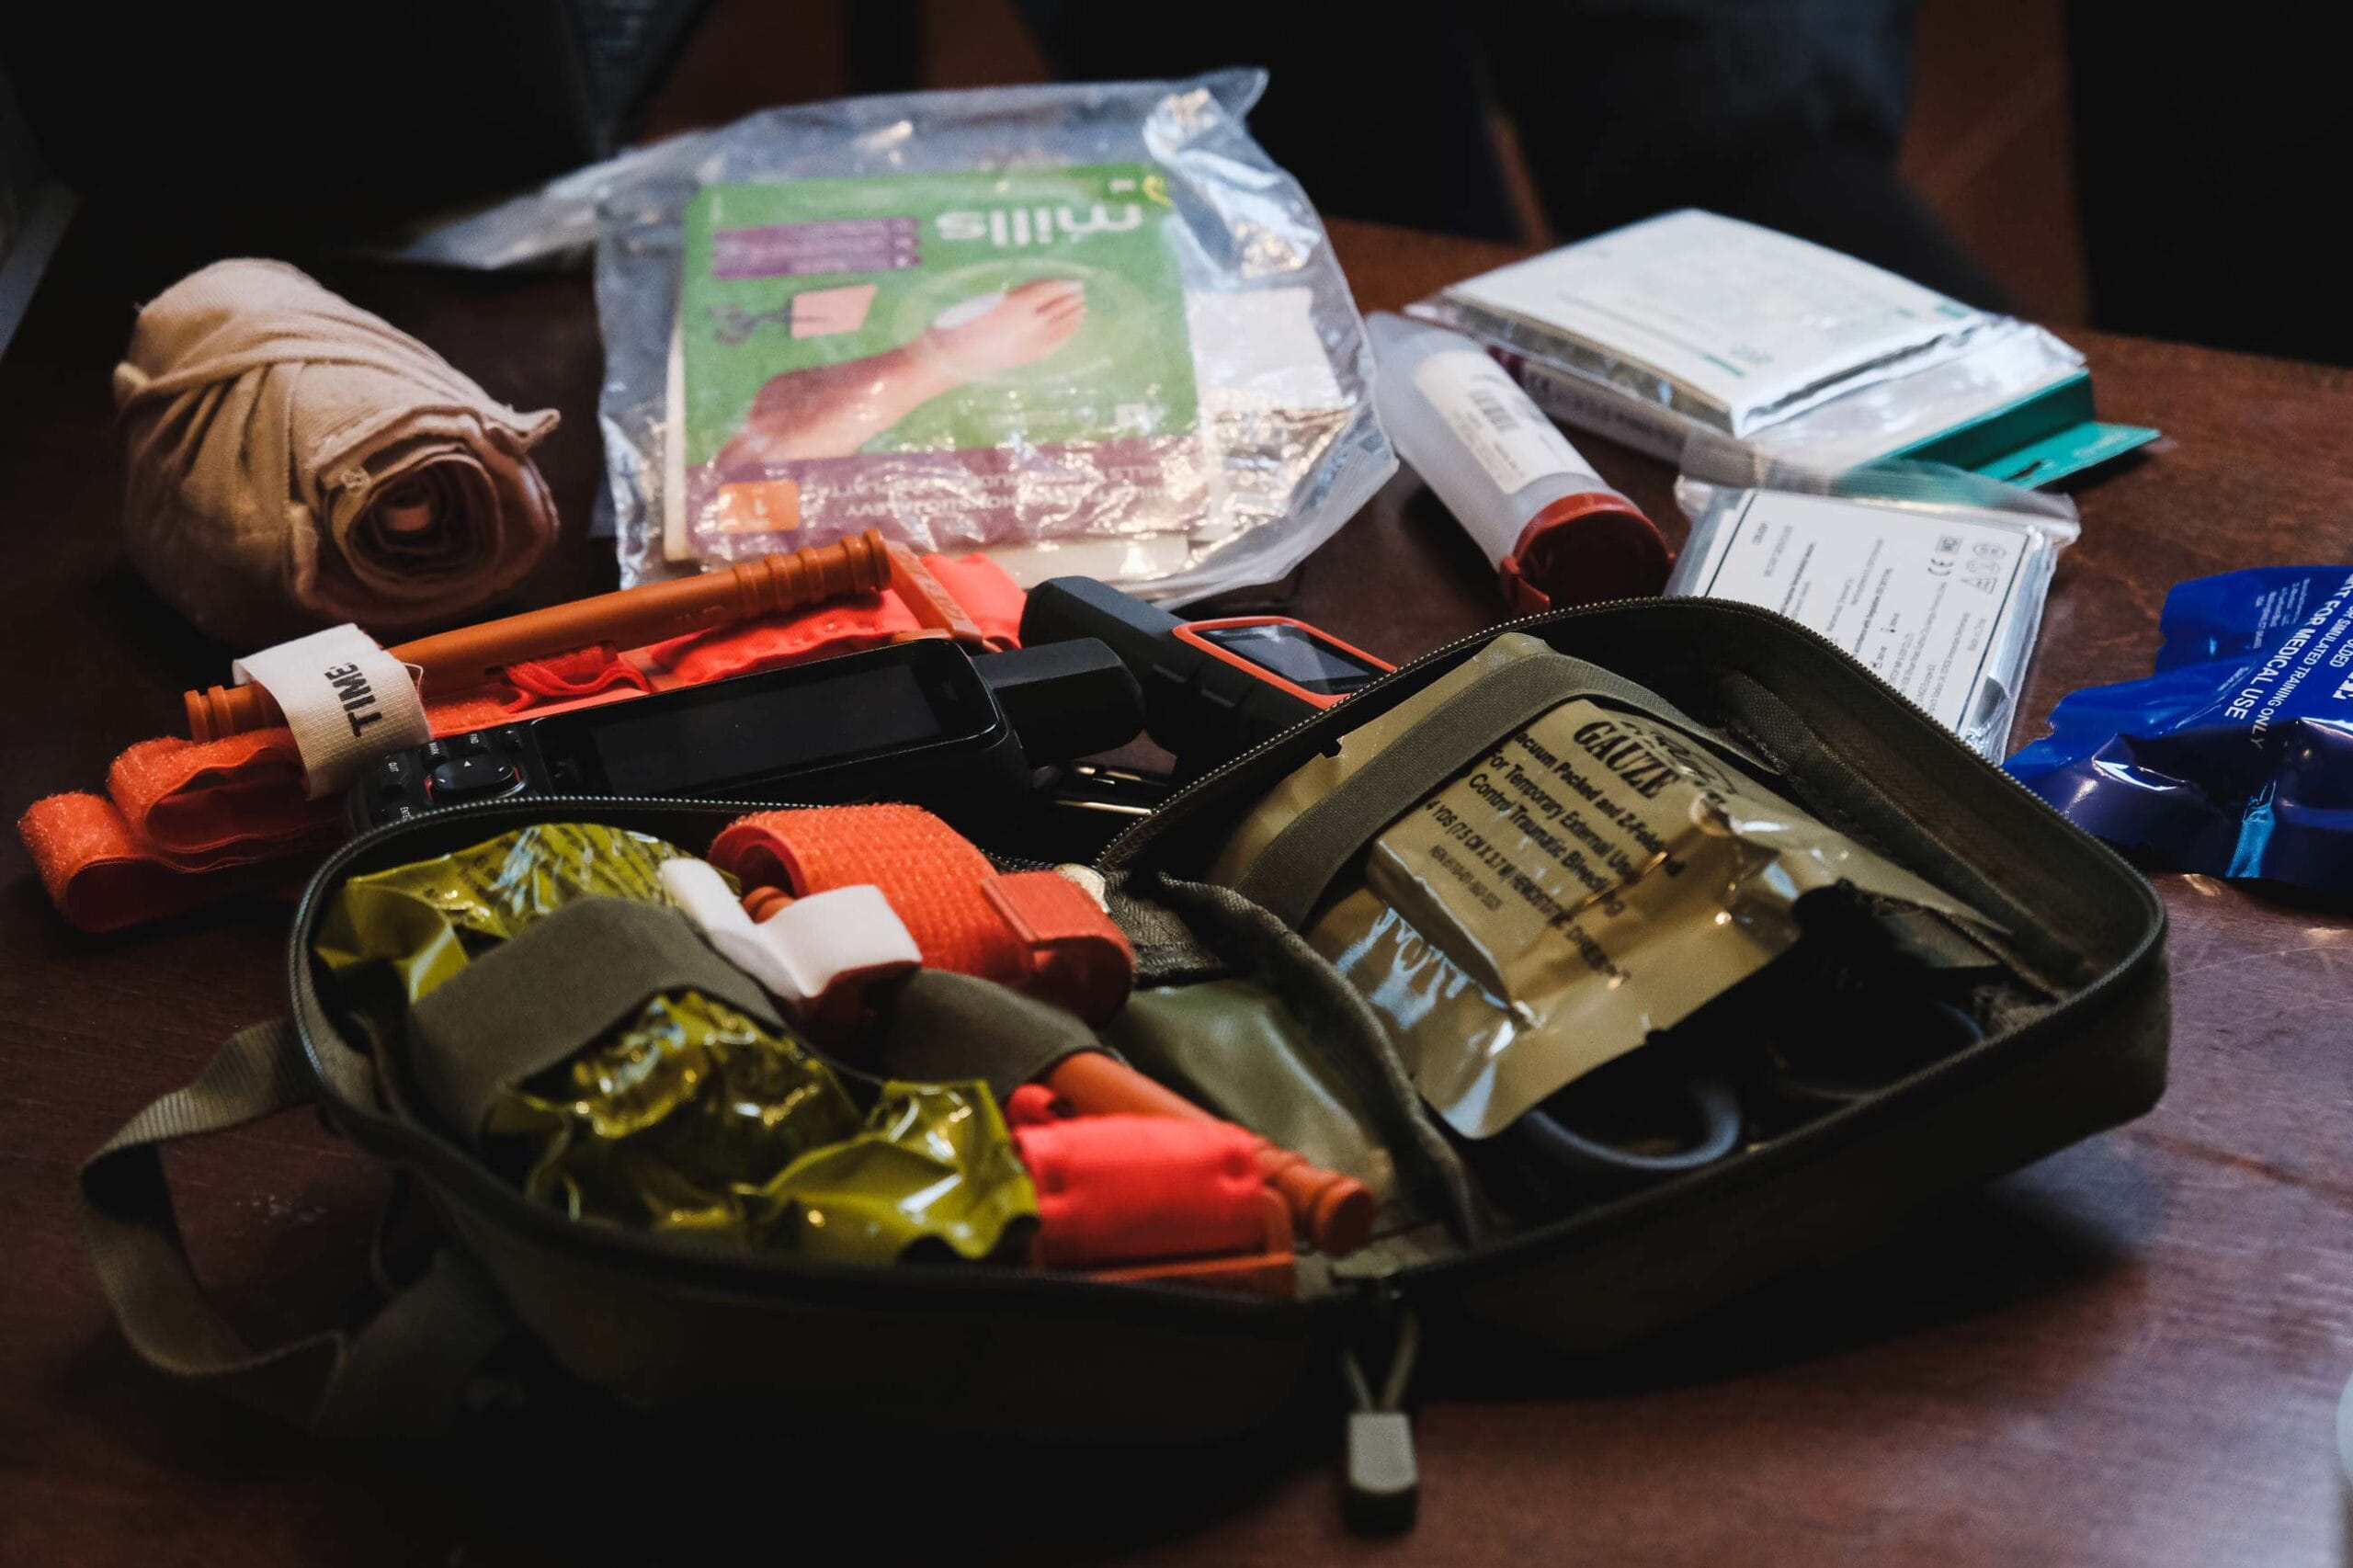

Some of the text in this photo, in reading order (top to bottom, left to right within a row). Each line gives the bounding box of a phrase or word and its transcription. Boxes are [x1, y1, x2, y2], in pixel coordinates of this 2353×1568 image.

[936, 204, 1142, 247] mills
[2304, 599, 2342, 627] FOR
[2250, 628, 2316, 685] MEDICAL
[2303, 618, 2351, 665] SIMULATED
[2224, 687, 2264, 720] USE
[2268, 665, 2312, 707] TRAINING
[2250, 708, 2275, 750] ONLY
[1573, 721, 1681, 800] GAUZE
[1505, 764, 1566, 820] Temporary
[1559, 811, 1617, 858] External
[1552, 762, 1605, 802] Packed
[1595, 798, 1626, 819] and
[1432, 804, 1458, 827] YDS
[1469, 774, 1517, 813] Control
[1508, 804, 1567, 858] Traumatic
